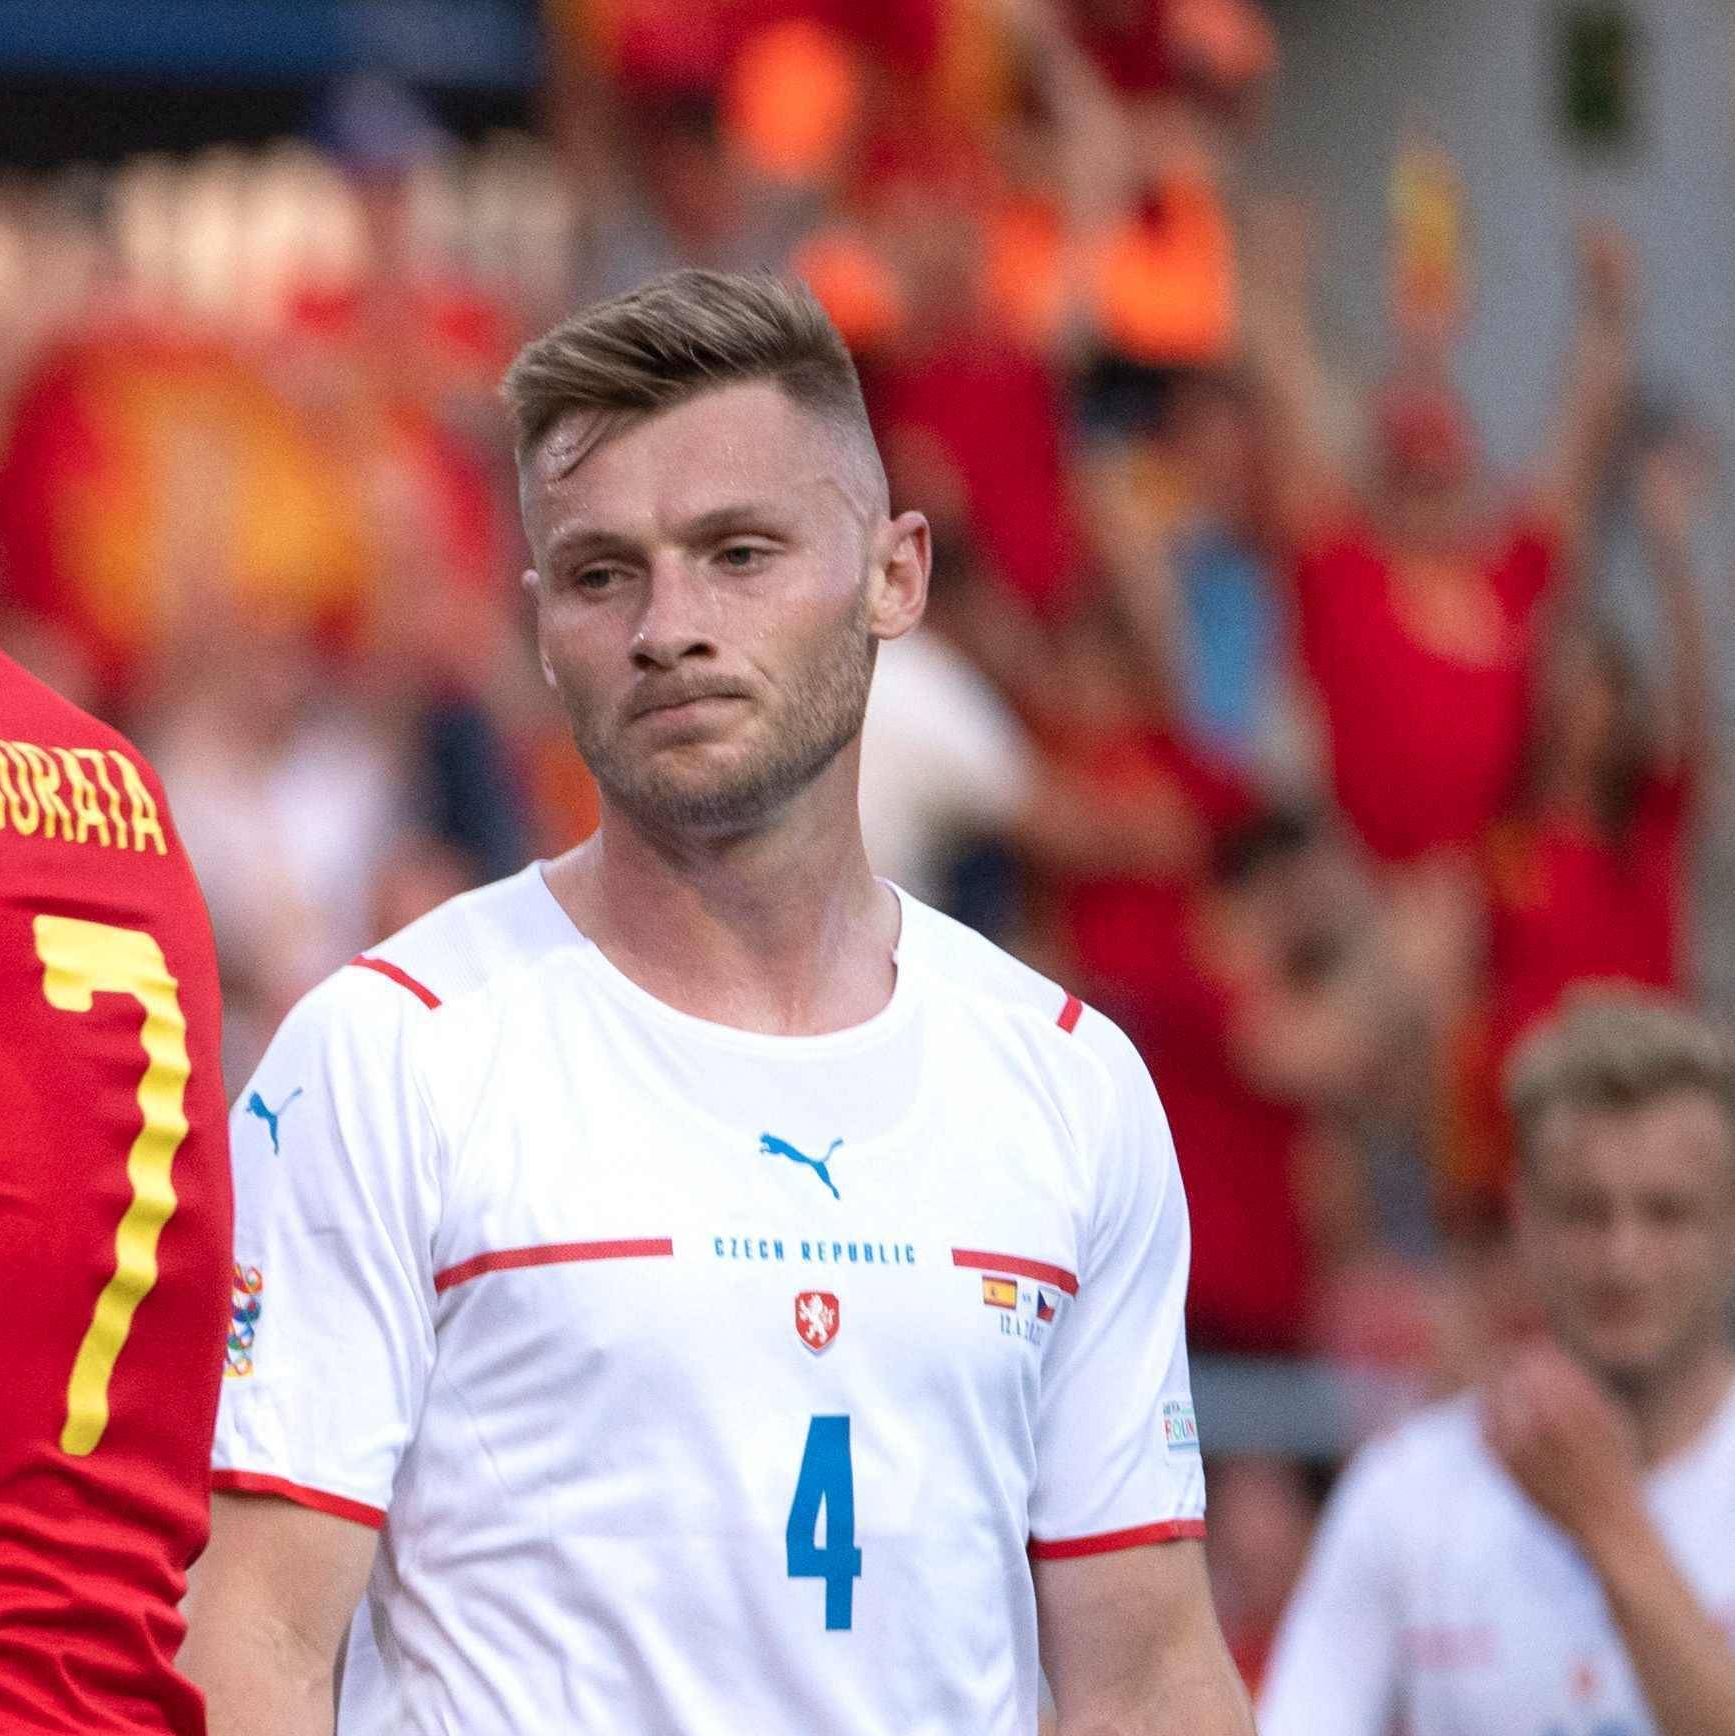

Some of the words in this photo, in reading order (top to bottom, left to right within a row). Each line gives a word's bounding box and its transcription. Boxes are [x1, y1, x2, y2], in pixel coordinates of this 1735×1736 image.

[32, 913, 191, 1456] 7
[714, 1236, 784, 1262] CZECH
[800, 1241, 916, 1265] REPUBLIC
[786, 1413, 862, 1631] 4
